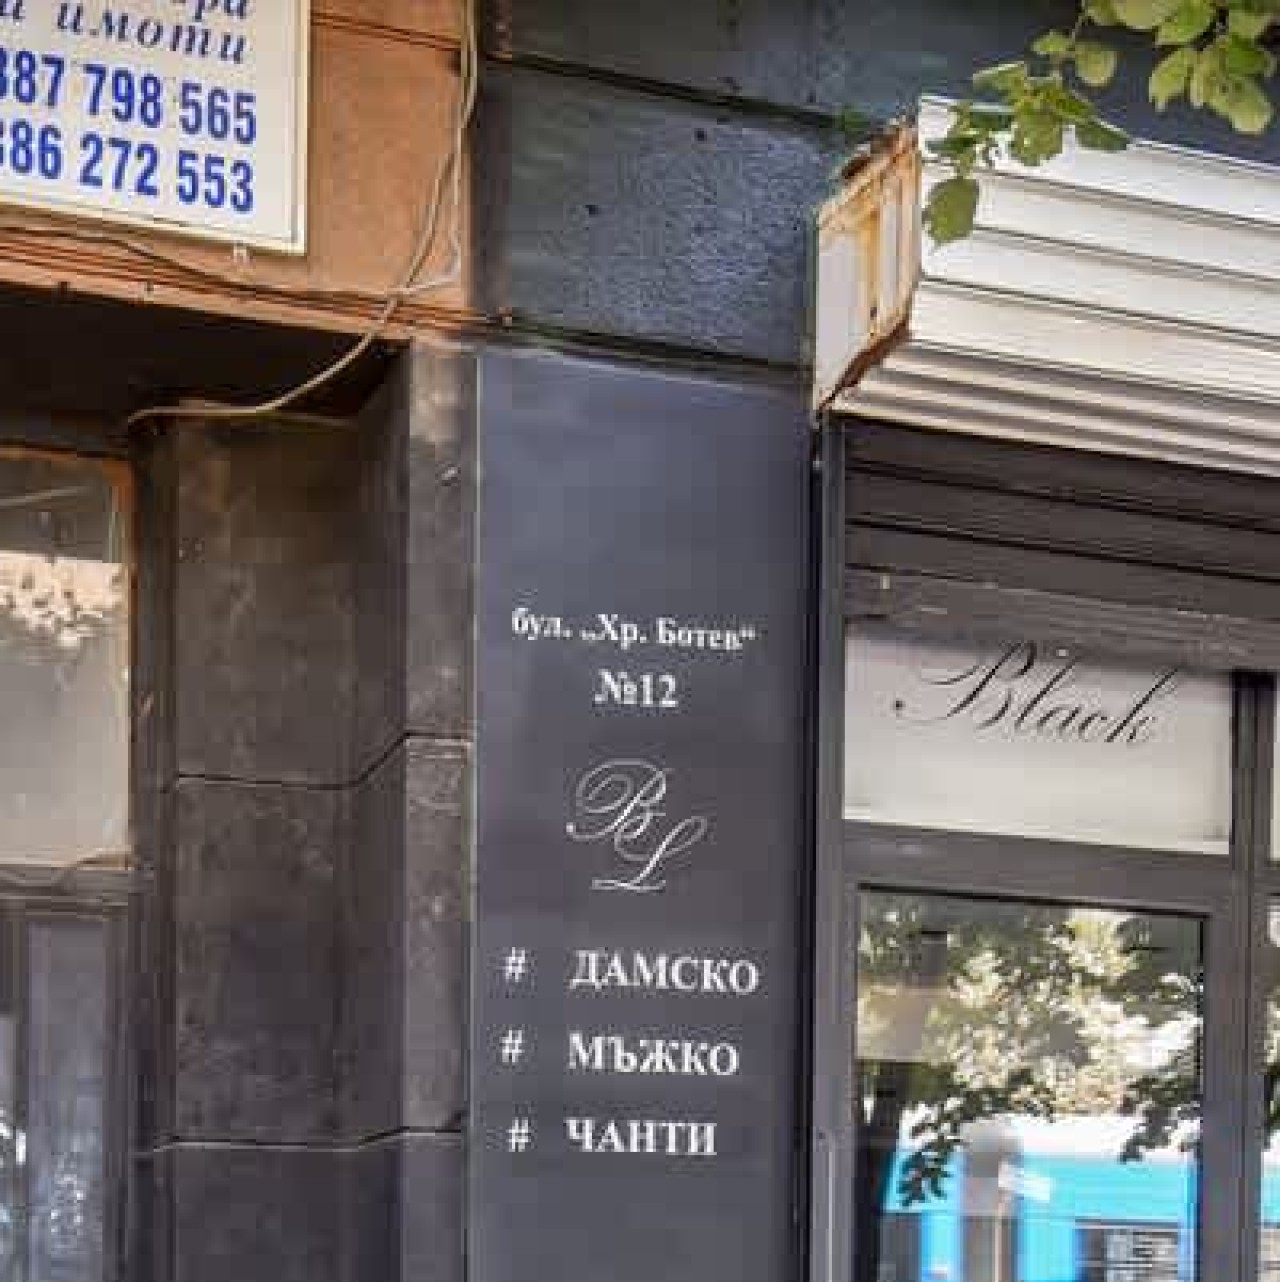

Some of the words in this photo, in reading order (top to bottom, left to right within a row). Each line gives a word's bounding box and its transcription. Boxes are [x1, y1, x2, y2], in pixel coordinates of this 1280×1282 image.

[84, 63, 163, 129] 798
[181, 81, 257, 145] 565
[79, 132, 160, 197] 272
[177, 149, 254, 214] 553
[511, 607, 573, 641] бул.
[593, 668, 680, 708] №12
[892, 640, 1184, 744] Black
[569, 950, 761, 995] ДАМСКО
[567, 1031, 741, 1077] МЪЖКО
[564, 1117, 719, 1157] ЧАНТИ
